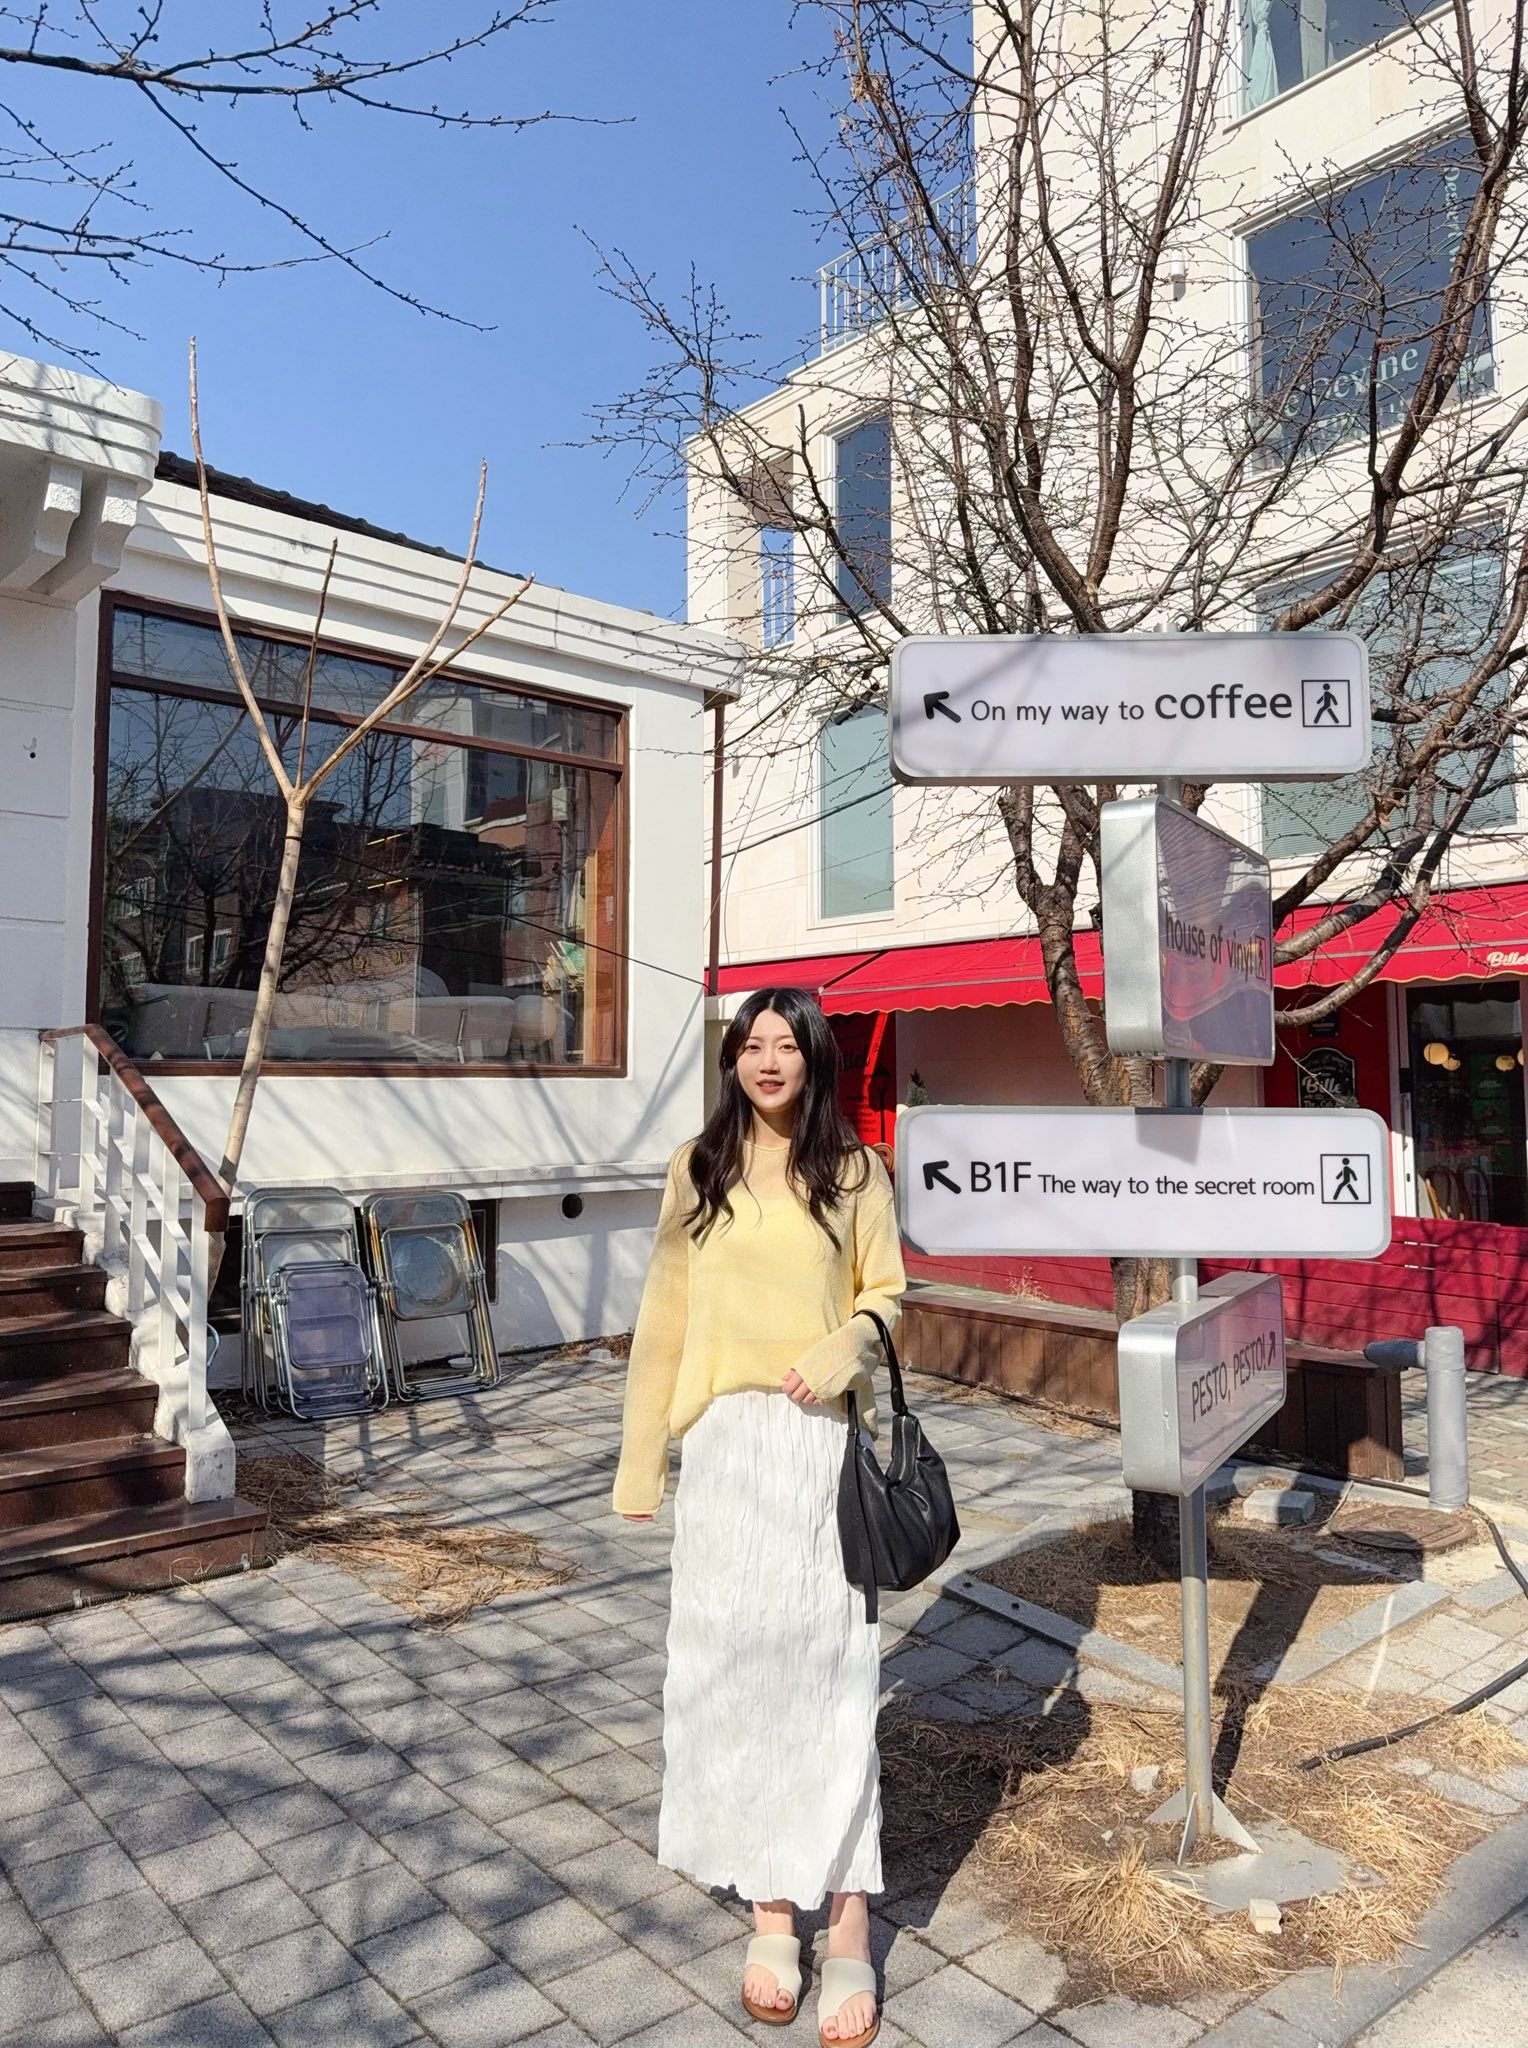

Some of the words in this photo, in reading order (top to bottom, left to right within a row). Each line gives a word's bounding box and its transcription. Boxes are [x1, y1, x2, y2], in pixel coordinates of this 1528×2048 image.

[971, 700, 1006, 721] On
[1016, 703, 1050, 726] my
[1062, 703, 1108, 725] way
[1117, 701, 1144, 721] to
[1155, 683, 1293, 720] coffee
[1165, 902, 1206, 959] house
[1209, 924, 1224, 964] of
[1226, 931, 1257, 983] vinyl
[970, 1161, 1032, 1193] B1F
[1038, 1174, 1077, 1195] The
[1082, 1176, 1123, 1199] way
[1128, 1177, 1150, 1195] to
[1155, 1175, 1189, 1195] the
[1194, 1177, 1256, 1196] secret
[1262, 1180, 1315, 1196] room
[1191, 1361, 1231, 1423] PESTO,
[1233, 1332, 1267, 1391] PESTO!
